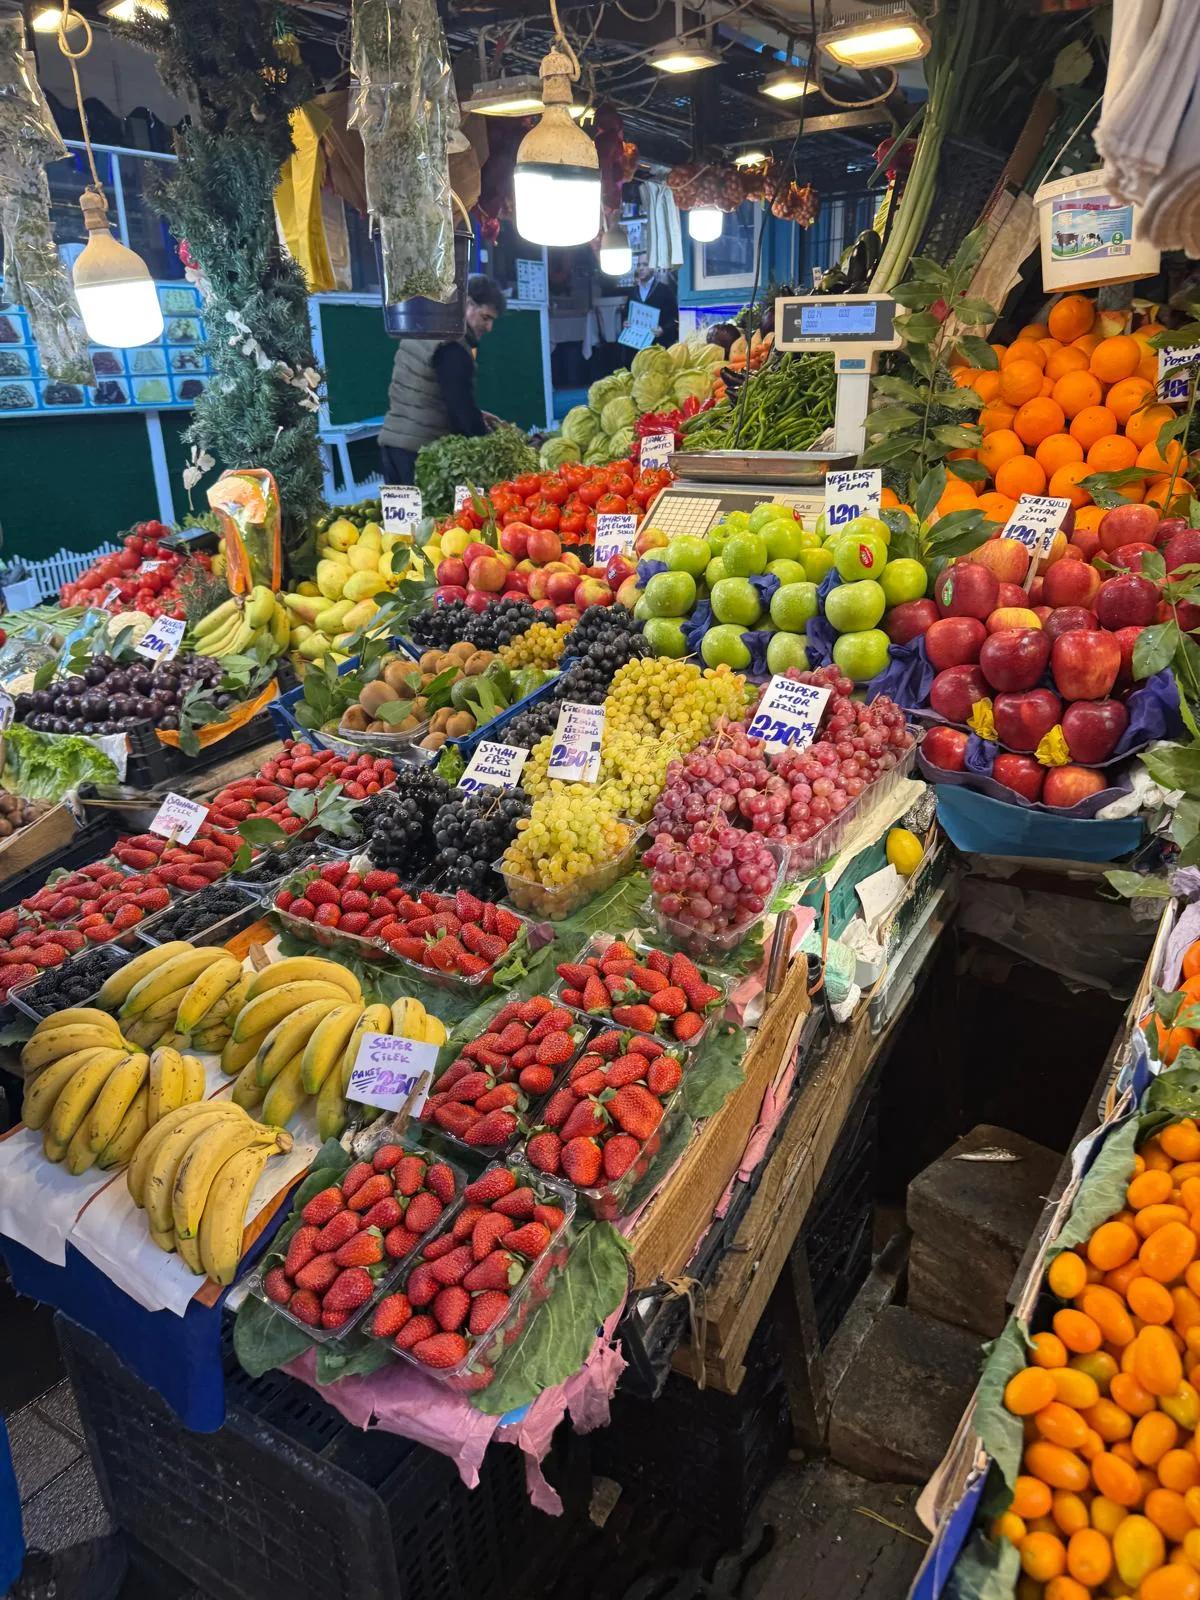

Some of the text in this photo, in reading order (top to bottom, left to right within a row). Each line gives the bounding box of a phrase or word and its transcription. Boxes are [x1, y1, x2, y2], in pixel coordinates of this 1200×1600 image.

[837, 481, 870, 492] ELMA
[827, 503, 860, 526] 120
[775, 680, 820, 700] SÜPER
[778, 693, 811, 707] MOR
[768, 698, 809, 718] ÜZÜM
[479, 743, 518, 760] SİYAH
[484, 753, 510, 766] EFES
[368, 1037, 413, 1052] SÜPER
[370, 1051, 410, 1064] ÇİLEK
[351, 1066, 382, 1080] PAKET
